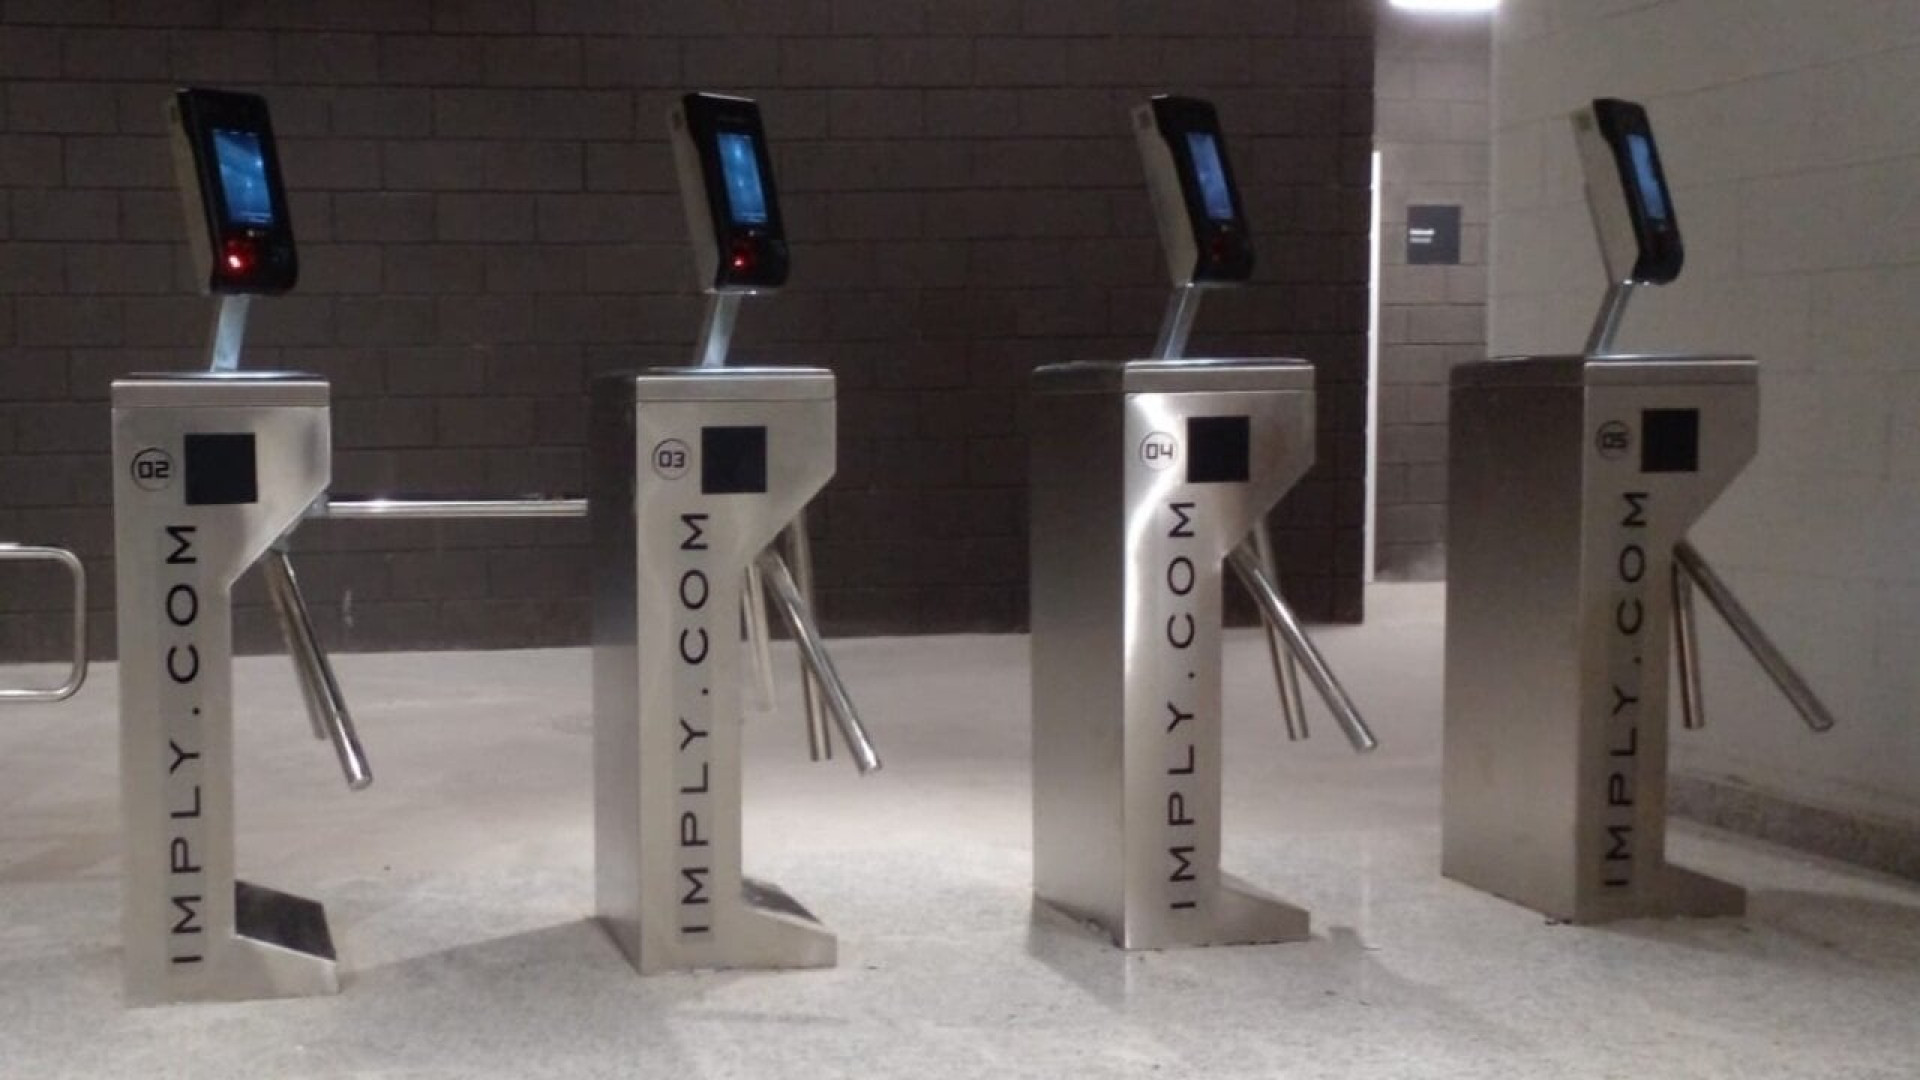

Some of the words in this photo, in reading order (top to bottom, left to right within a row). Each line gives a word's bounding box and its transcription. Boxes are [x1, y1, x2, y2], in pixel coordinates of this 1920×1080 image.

[138, 462, 170, 479] 02
[660, 450, 685, 468] 03
[1146, 443, 1173, 460] 04
[166, 525, 202, 965] IMPLY.COM
[680, 513, 709, 934] IMPLY.COM
[1167, 502, 1196, 910] IMPLY.COM
[1604, 491, 1649, 887] IMPLY.COM
